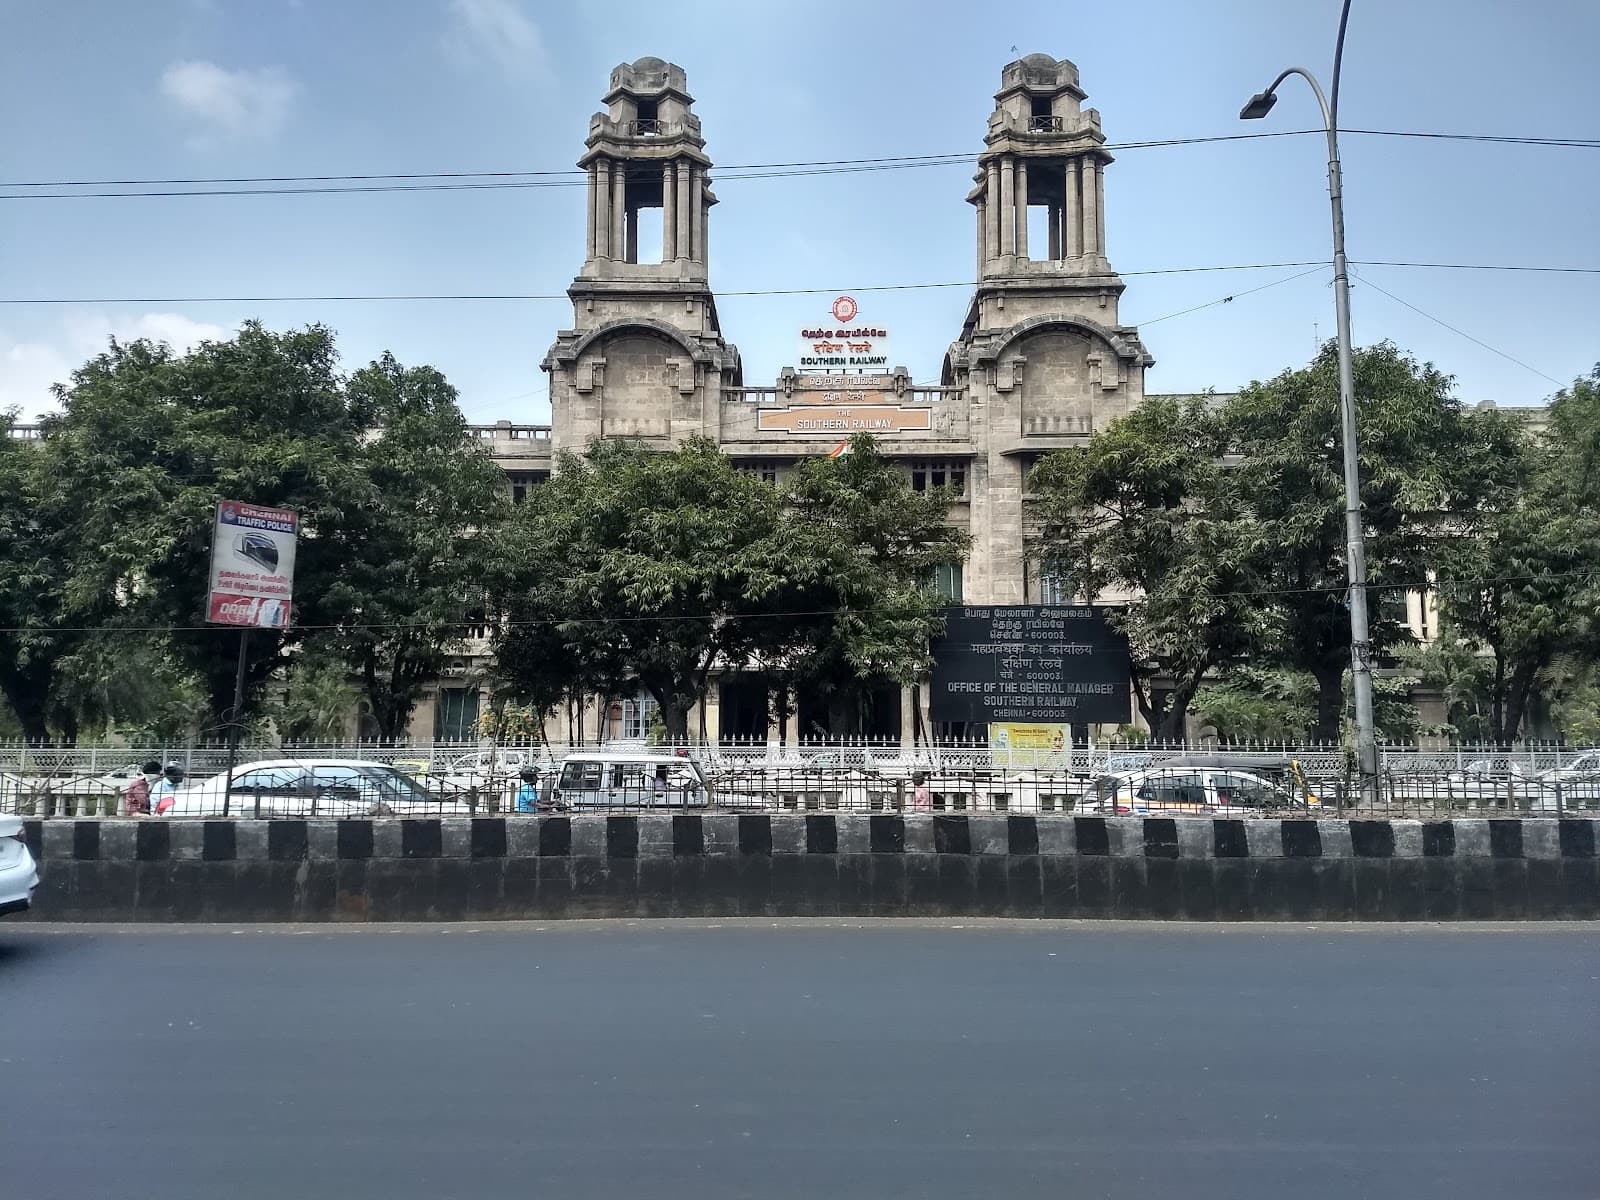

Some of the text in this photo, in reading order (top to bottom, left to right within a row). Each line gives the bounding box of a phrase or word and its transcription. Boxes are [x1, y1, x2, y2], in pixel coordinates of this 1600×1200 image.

[800, 356, 887, 365] SOUTHERN RAILWAY
[797, 419, 893, 430] SOUTHERN RAILWAY
[240, 508, 292, 522] CHENNAI
[237, 516, 293, 532] TRAFFIC POLICE
[964, 608, 991, 619] பொது
[1002, 655, 1063, 669] दक्षिण रेलवे
[948, 682, 1114, 694] OFFICE OF THE GENERAL MANAGER
[983, 695, 1035, 706] SOUTHERN
